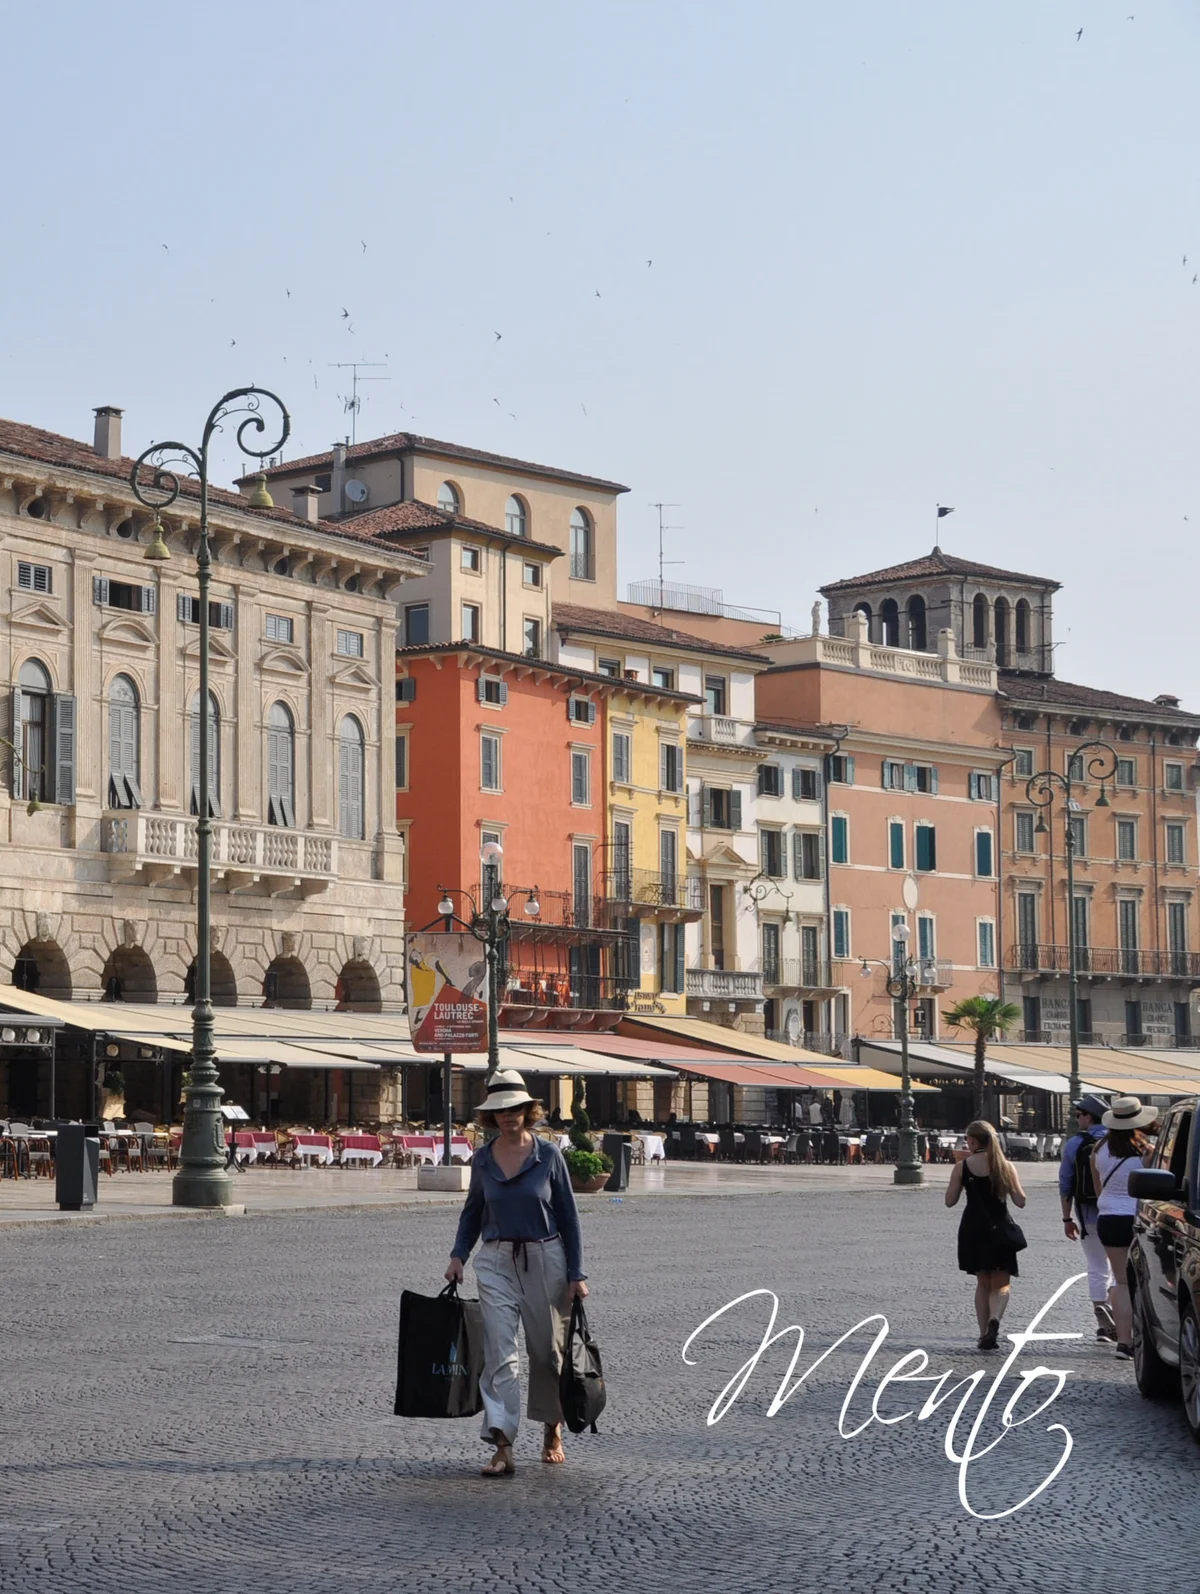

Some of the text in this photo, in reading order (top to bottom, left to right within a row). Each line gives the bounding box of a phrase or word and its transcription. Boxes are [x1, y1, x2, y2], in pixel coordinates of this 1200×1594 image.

[434, 1003, 484, 1012] TOULOUSE-
[1042, 998, 1071, 1010] BANC
[1142, 1001, 1173, 1013] BANCA
[434, 1011, 474, 1020] LAUTREC
